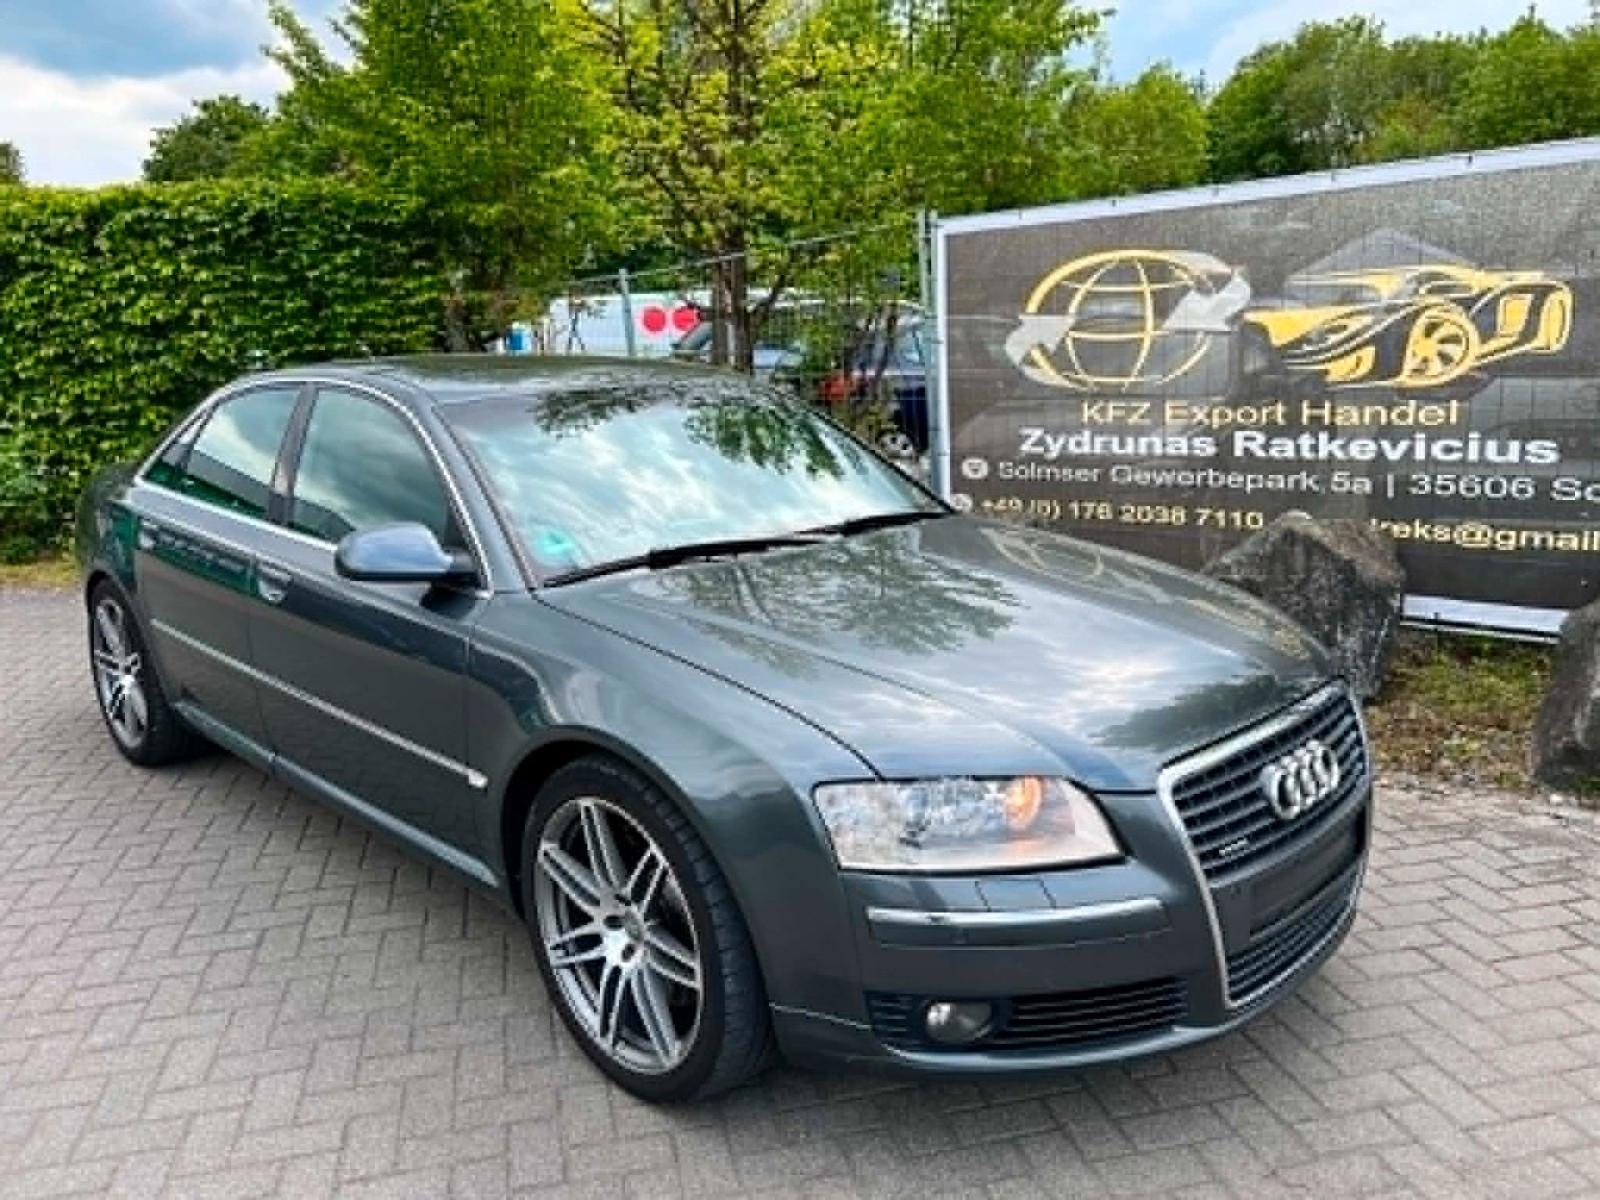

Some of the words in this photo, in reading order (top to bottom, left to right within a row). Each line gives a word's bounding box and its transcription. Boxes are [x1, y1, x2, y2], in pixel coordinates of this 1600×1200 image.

[1081, 400, 1152, 424] KFZ
[1165, 400, 1286, 428] Export
[1301, 400, 1460, 426] Handel
[1019, 427, 1218, 458] Zydrunas
[1233, 430, 1561, 464] Ratkevicius
[1409, 474, 1536, 499] 35606
[1195, 507, 1264, 529] 7110
